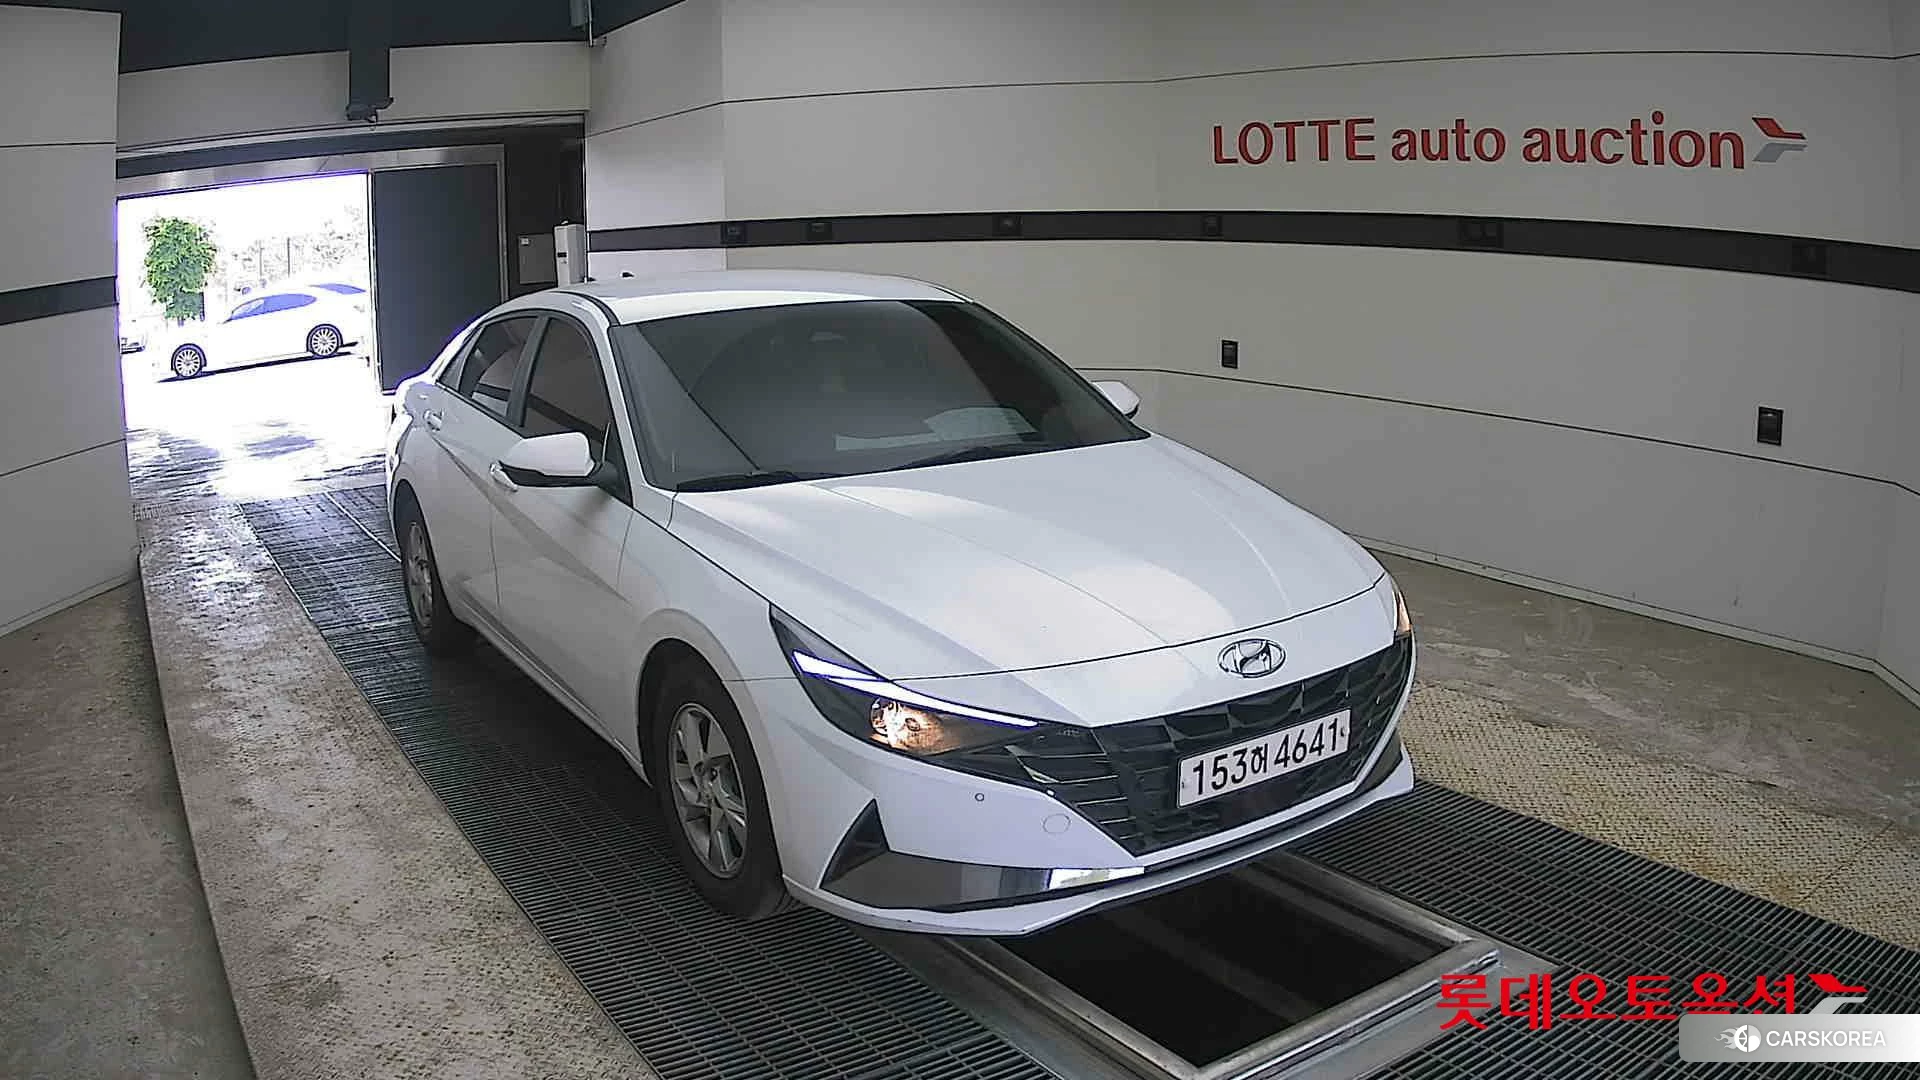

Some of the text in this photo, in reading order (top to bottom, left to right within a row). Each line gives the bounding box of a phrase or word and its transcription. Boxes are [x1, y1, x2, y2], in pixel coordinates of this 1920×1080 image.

[1213, 110, 1746, 170] LOTTE auto auction
[1193, 718, 1338, 795] 153허 4641
